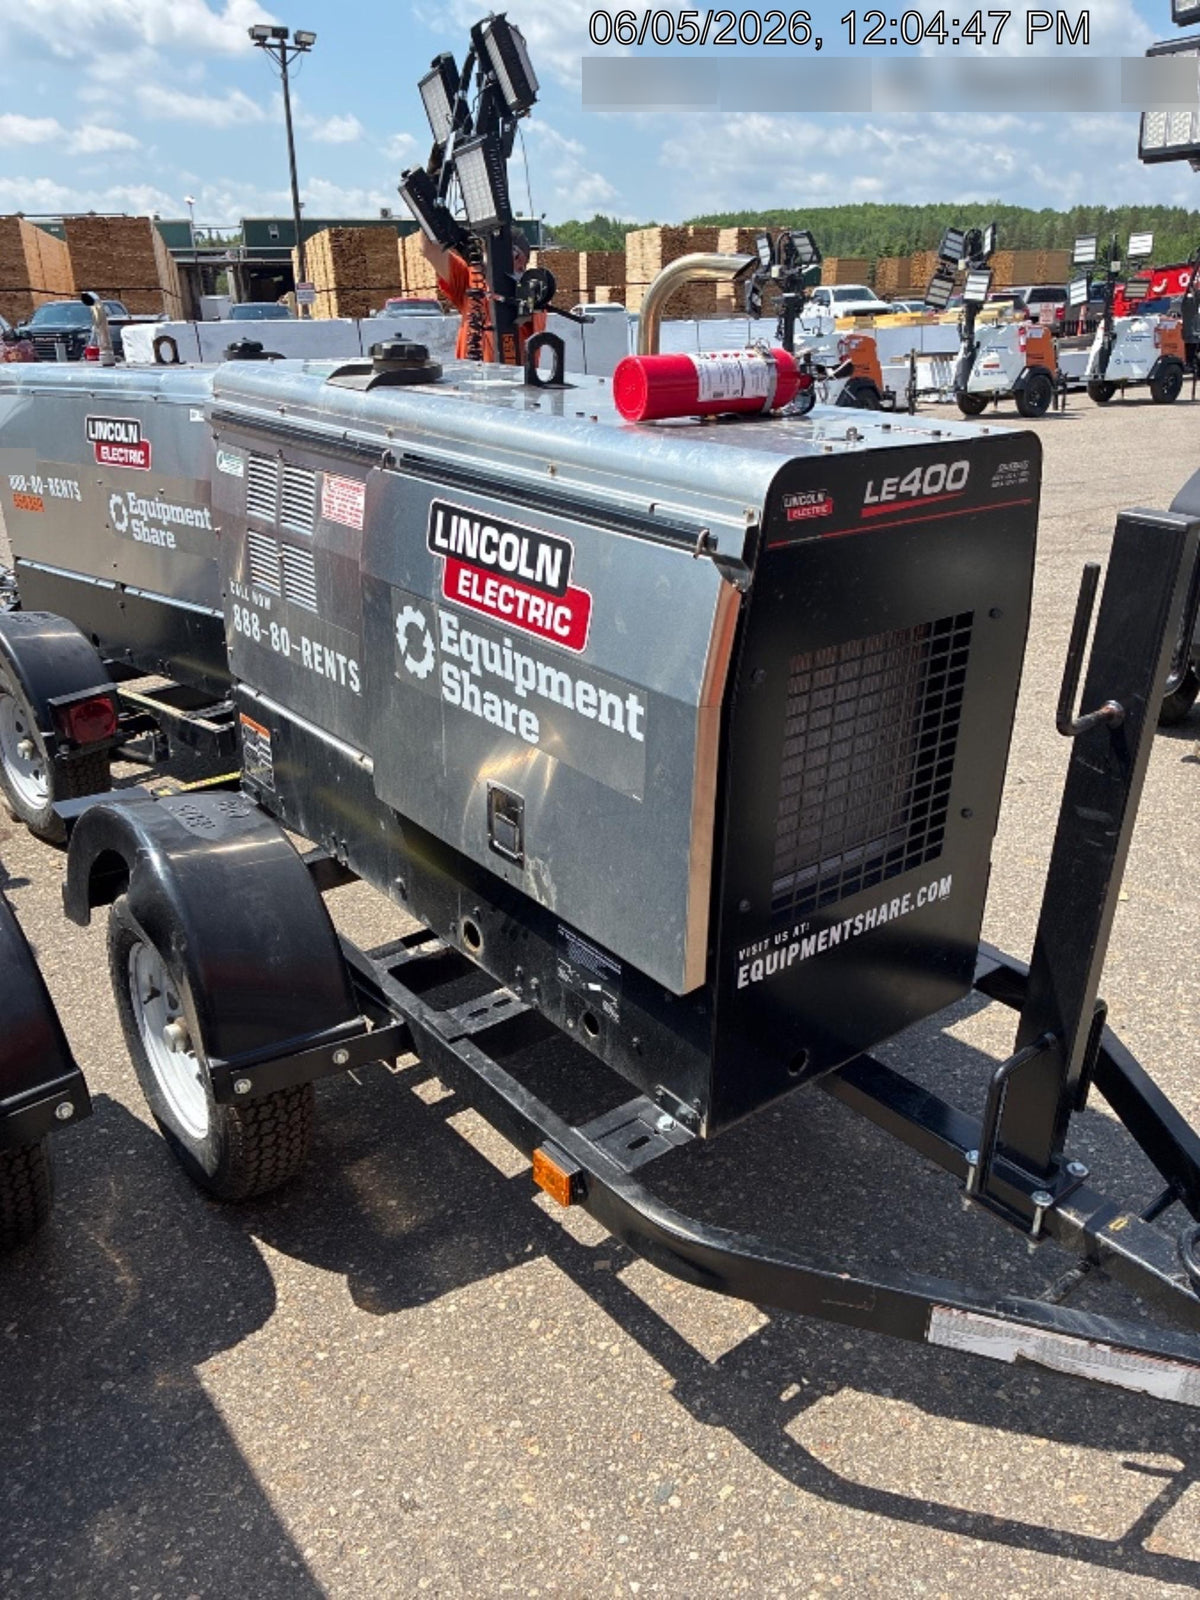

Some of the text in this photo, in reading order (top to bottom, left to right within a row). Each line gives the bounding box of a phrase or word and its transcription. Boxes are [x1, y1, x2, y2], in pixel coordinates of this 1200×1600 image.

[87, 420, 139, 444] LINCOLN
[101, 445, 145, 465] ELECTRIC
[783, 493, 826, 508] LINCOLN
[863, 460, 970, 504] LE400
[127, 491, 212, 530] Equipment
[792, 504, 828, 519] ELECTRIC
[131, 518, 177, 549] Share
[434, 509, 563, 589] LINCOLN
[456, 567, 573, 638] ELECTRIC
[233, 603, 361, 693] 888-80-RENTS
[437, 608, 645, 742] Equipment
[441, 660, 540, 744] Share
[736, 873, 953, 990] EQUIPMENTSHARE.COM
[738, 921, 810, 961] VISIT US AT:
